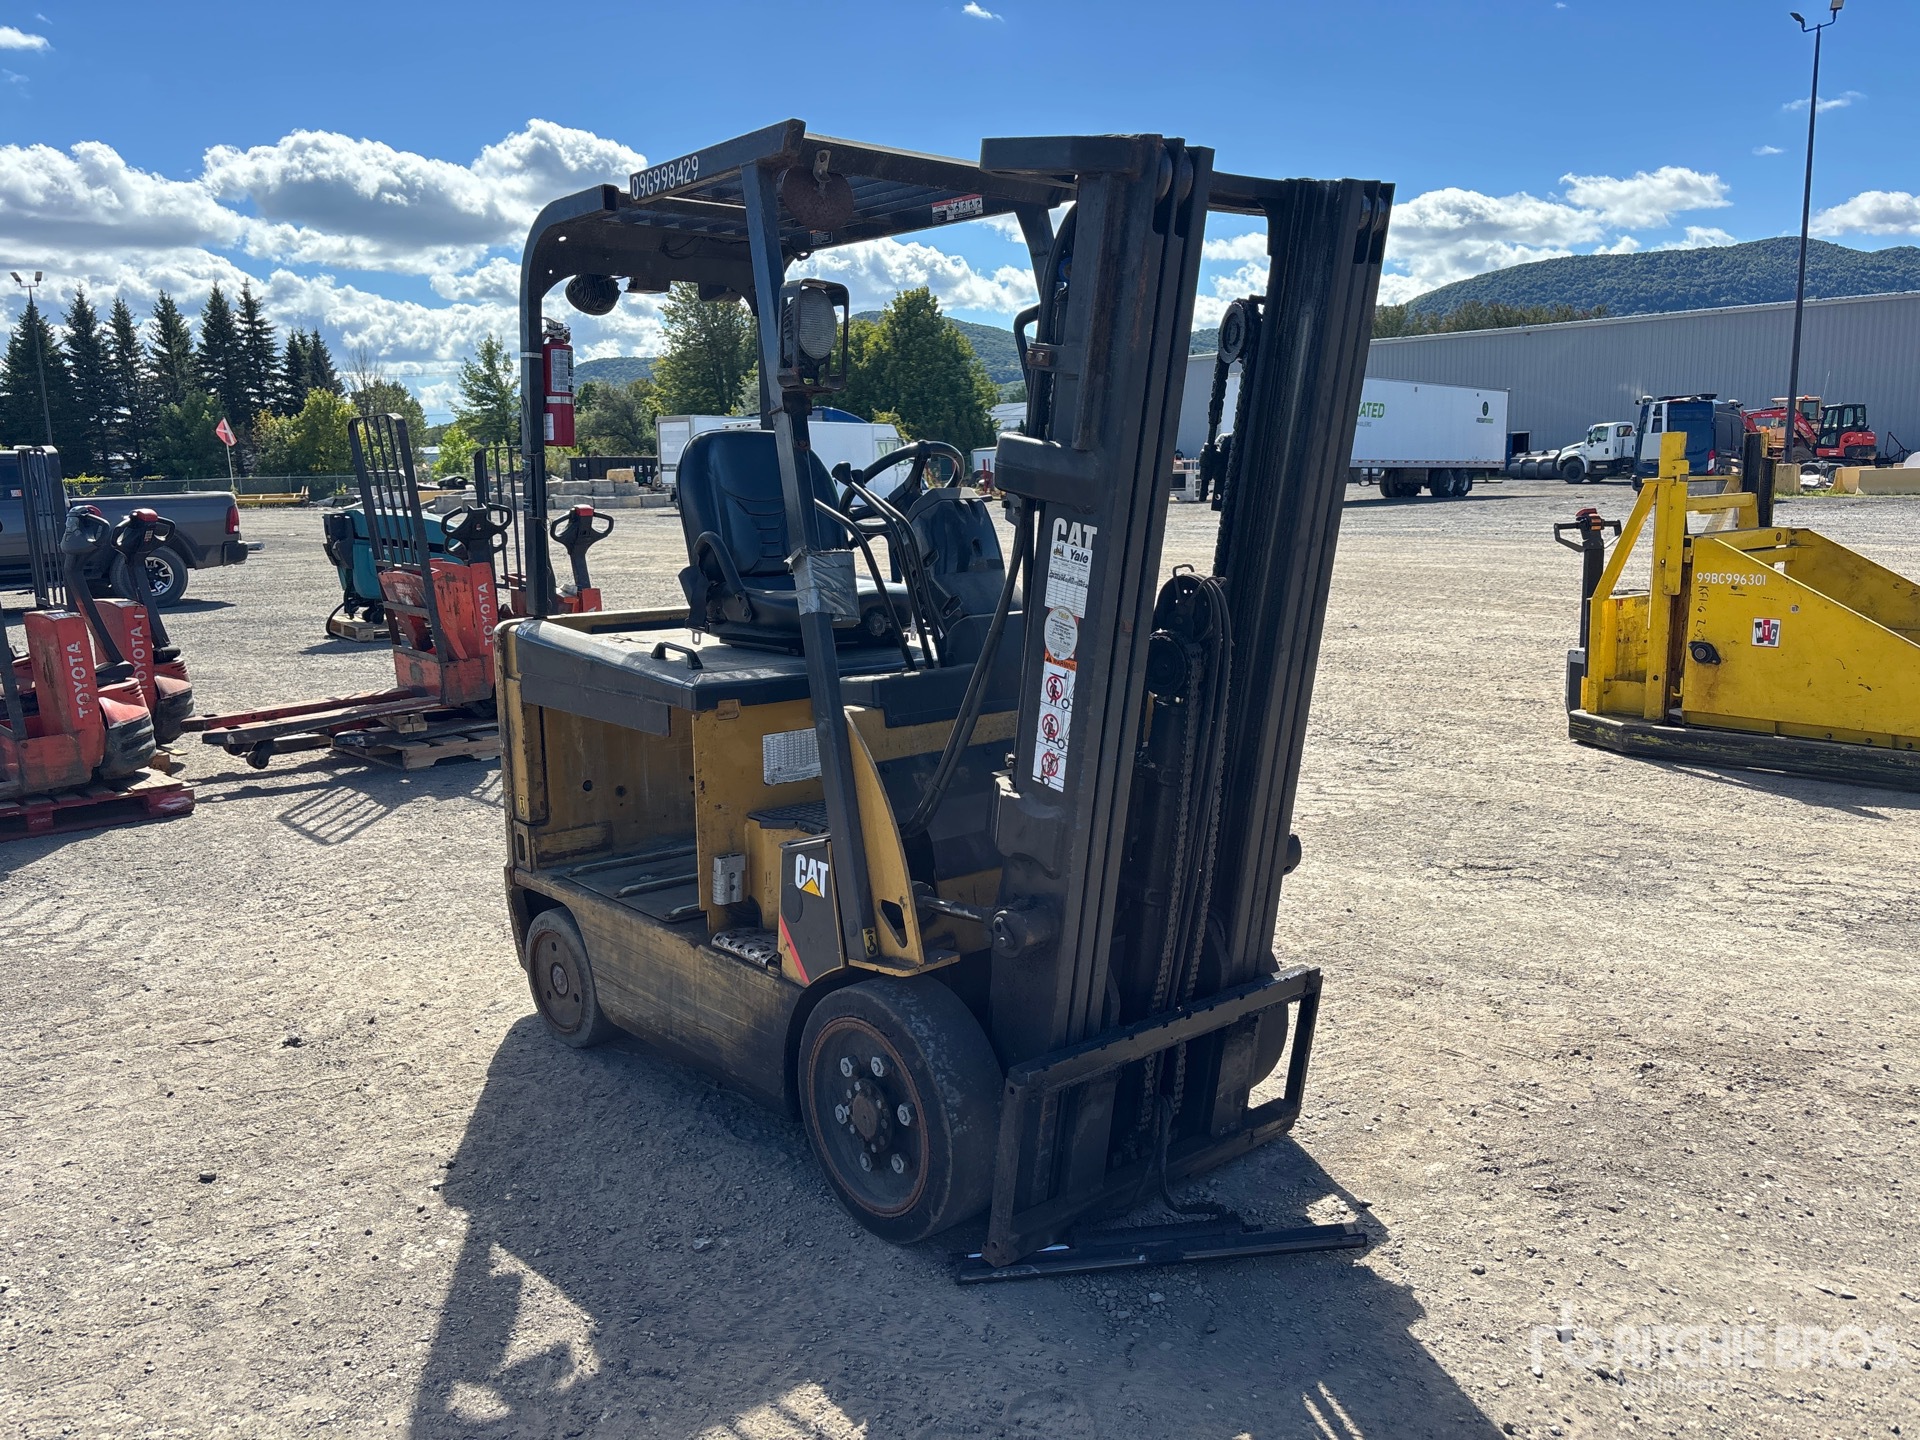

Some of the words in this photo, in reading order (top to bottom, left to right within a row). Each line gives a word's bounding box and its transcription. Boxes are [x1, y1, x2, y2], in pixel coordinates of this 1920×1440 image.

[632, 155, 699, 200] 09G998429
[1358, 401, 1385, 418] ATED
[1052, 517, 1098, 550] CAT
[1070, 548, 1089, 564] Yale
[1696, 572, 1767, 586] 99BC996301
[477, 582, 494, 646] TOYOTA
[1755, 625, 1777, 640] MTC
[66, 640, 93, 718] TOYOTA
[795, 853, 829, 899] CAT
